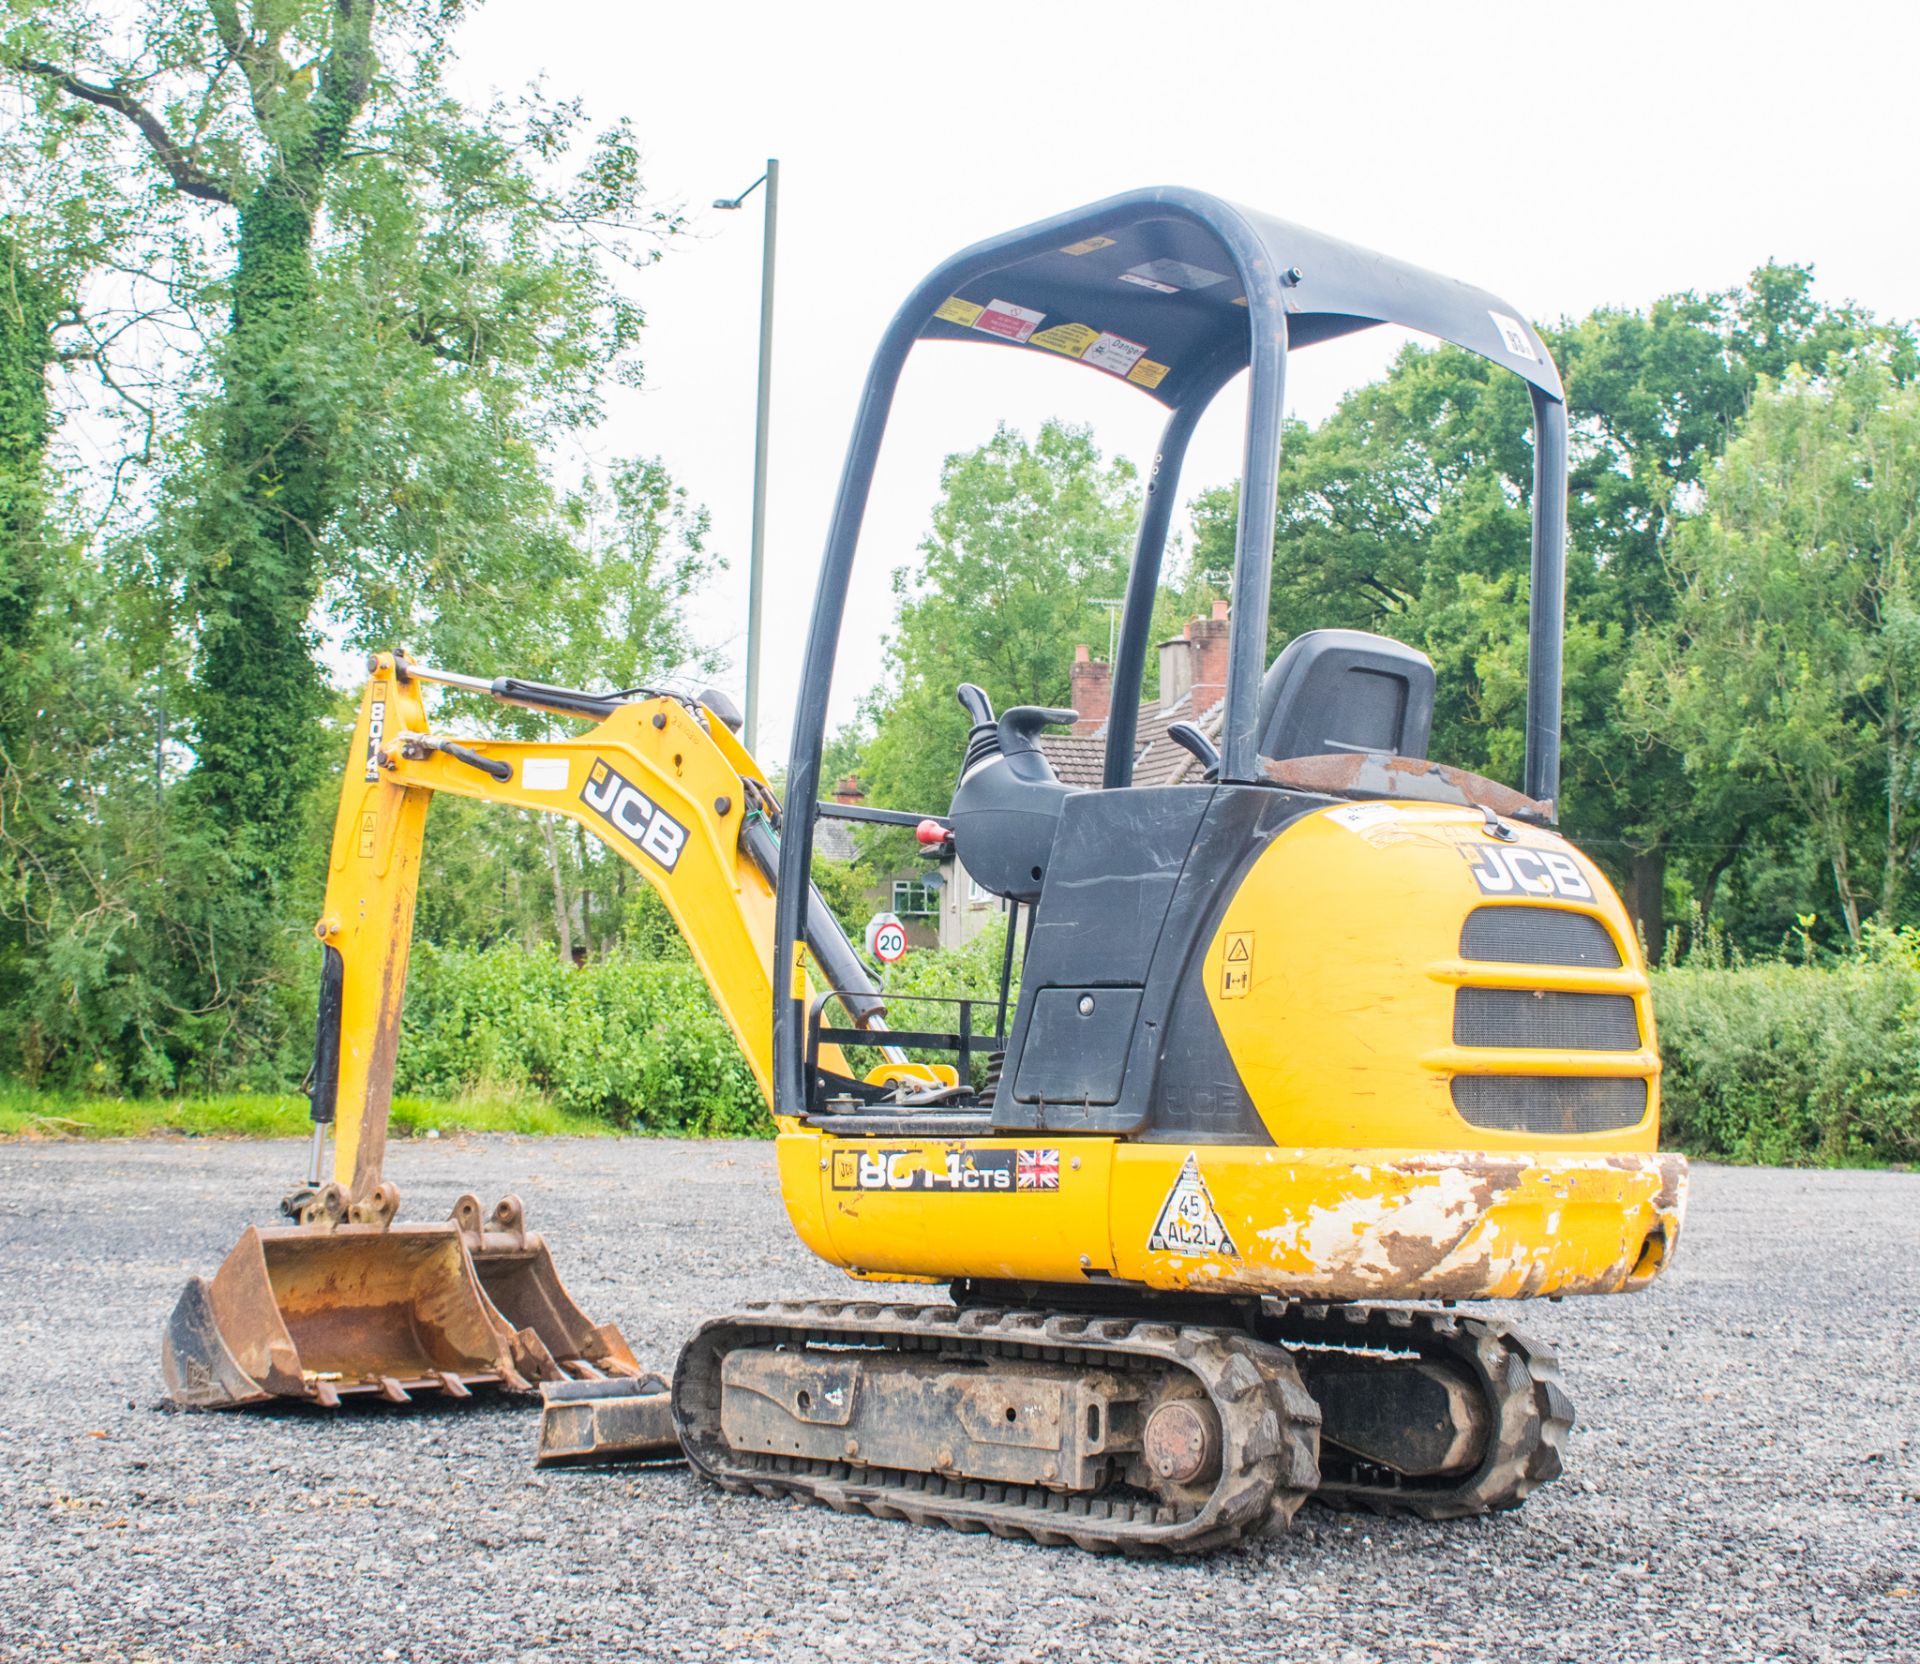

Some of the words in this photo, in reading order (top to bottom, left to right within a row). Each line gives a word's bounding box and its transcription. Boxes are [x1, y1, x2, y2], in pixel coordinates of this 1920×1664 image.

[1112, 339, 1143, 355] Danger
[366, 703, 385, 772] 8014
[584, 774, 685, 867] JCB
[1473, 846, 1592, 898] JCB
[880, 935, 902, 951] 20
[963, 1169, 1010, 1188] CTS
[1178, 1195, 1200, 1217] 45
